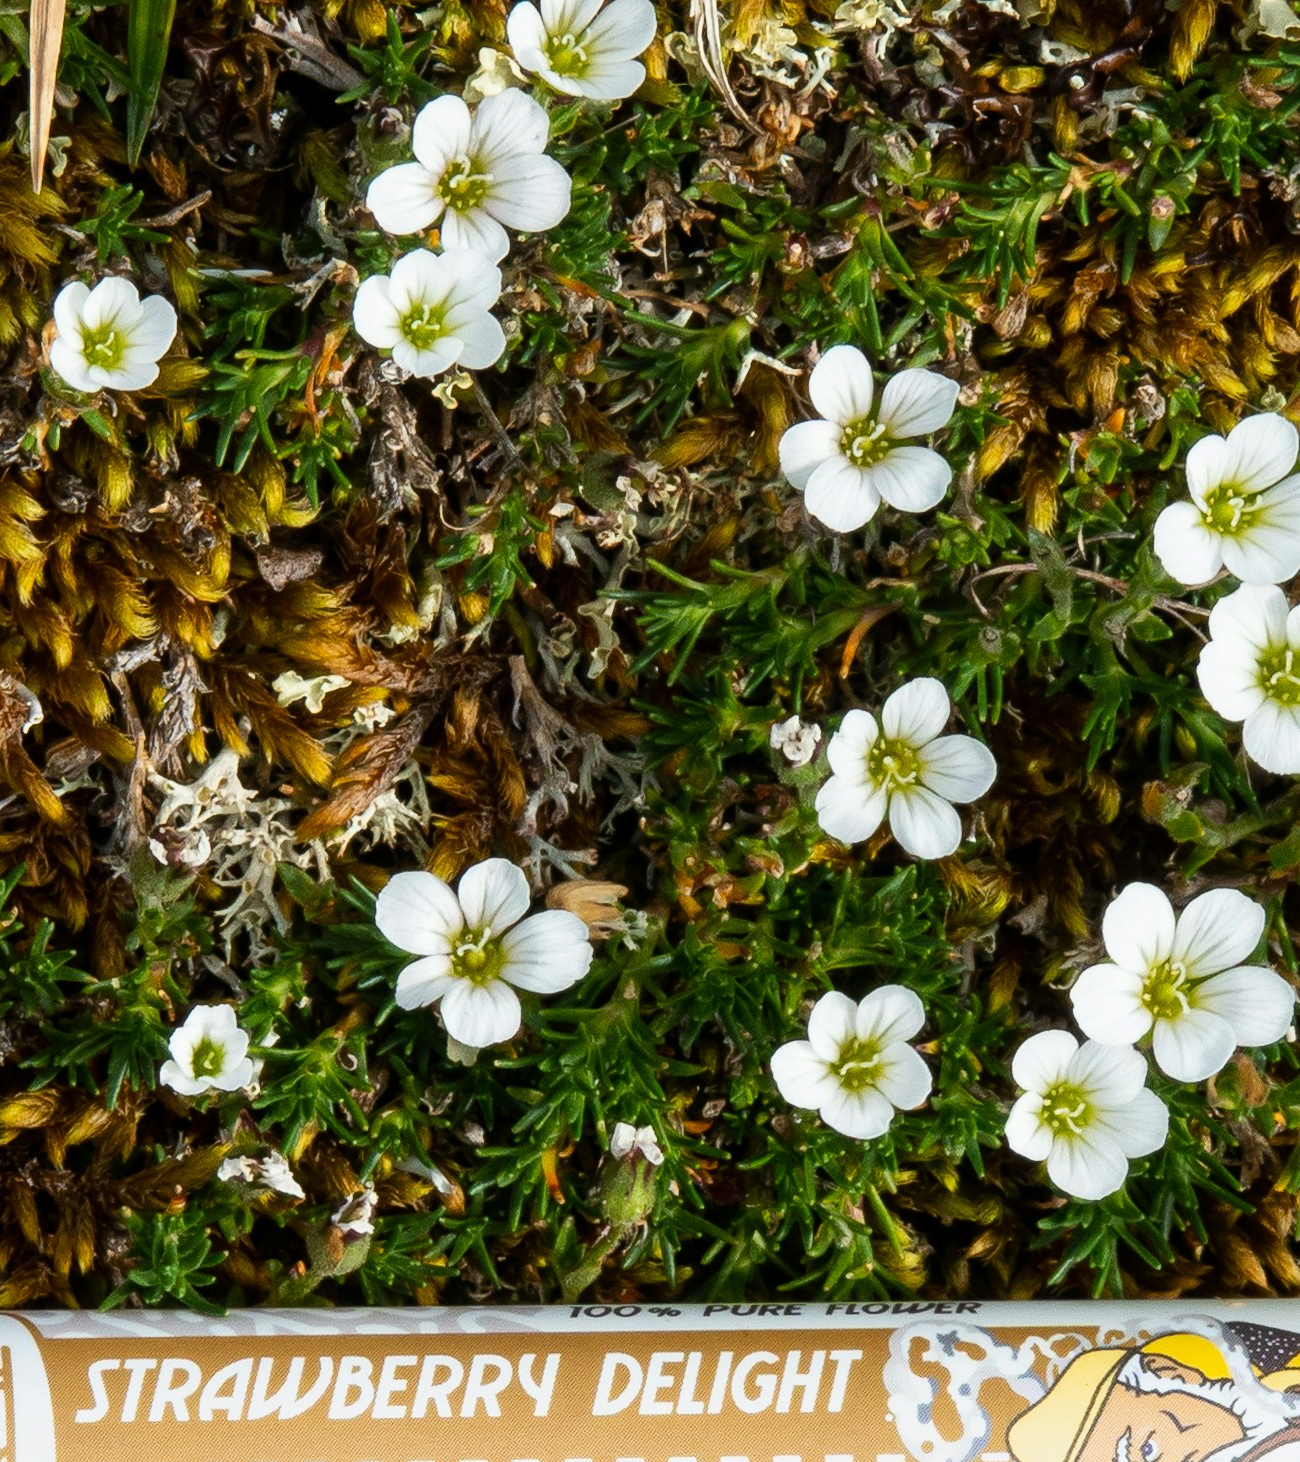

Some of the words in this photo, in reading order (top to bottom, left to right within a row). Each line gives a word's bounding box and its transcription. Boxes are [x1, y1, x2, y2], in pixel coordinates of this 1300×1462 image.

[702, 1303, 806, 1317] PURE
[825, 1301, 983, 1316] FLOWER
[75, 1353, 561, 1424] STRAWBERRY
[592, 1349, 863, 1417] DELIGHT
